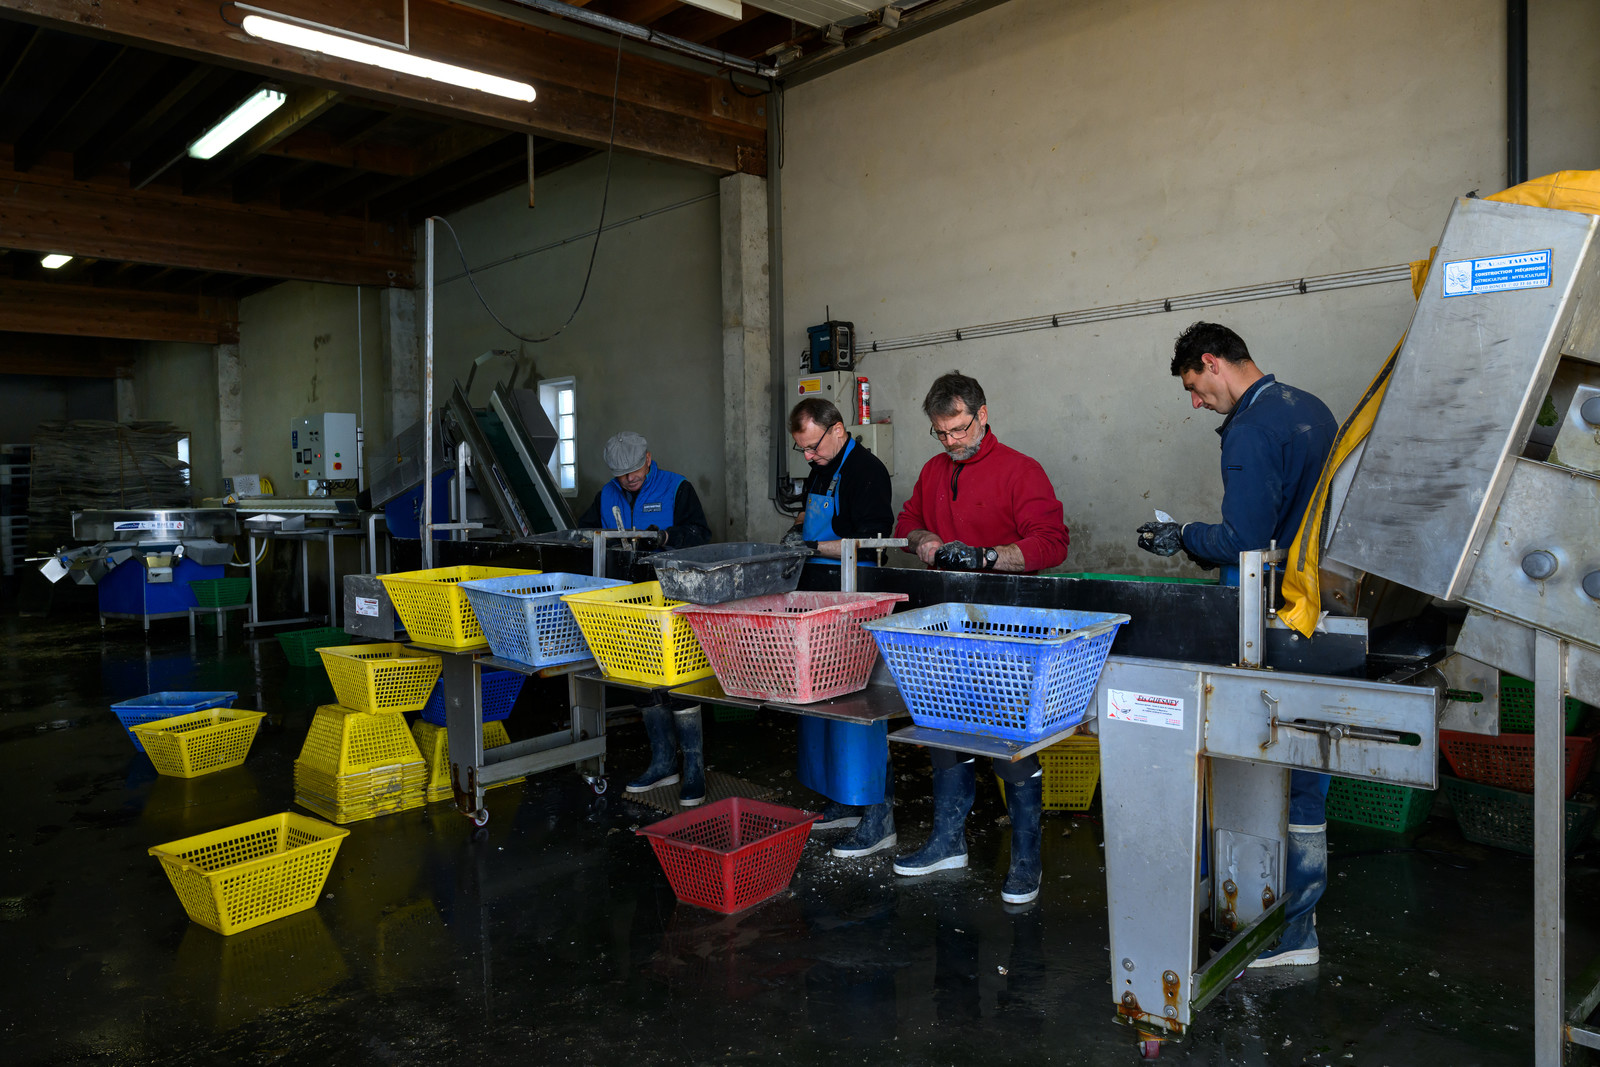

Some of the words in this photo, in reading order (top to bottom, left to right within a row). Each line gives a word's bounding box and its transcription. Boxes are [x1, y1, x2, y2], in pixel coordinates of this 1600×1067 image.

[1474, 269, 1513, 277] CONSTRUCTION
[1514, 265, 1546, 273] MÉCANIQUE
[1474, 276, 1509, 284] OSTREICULTURE
[1511, 272, 1546, 280] MYTILICULTURE
[1147, 696, 1179, 706] GUESNEY
